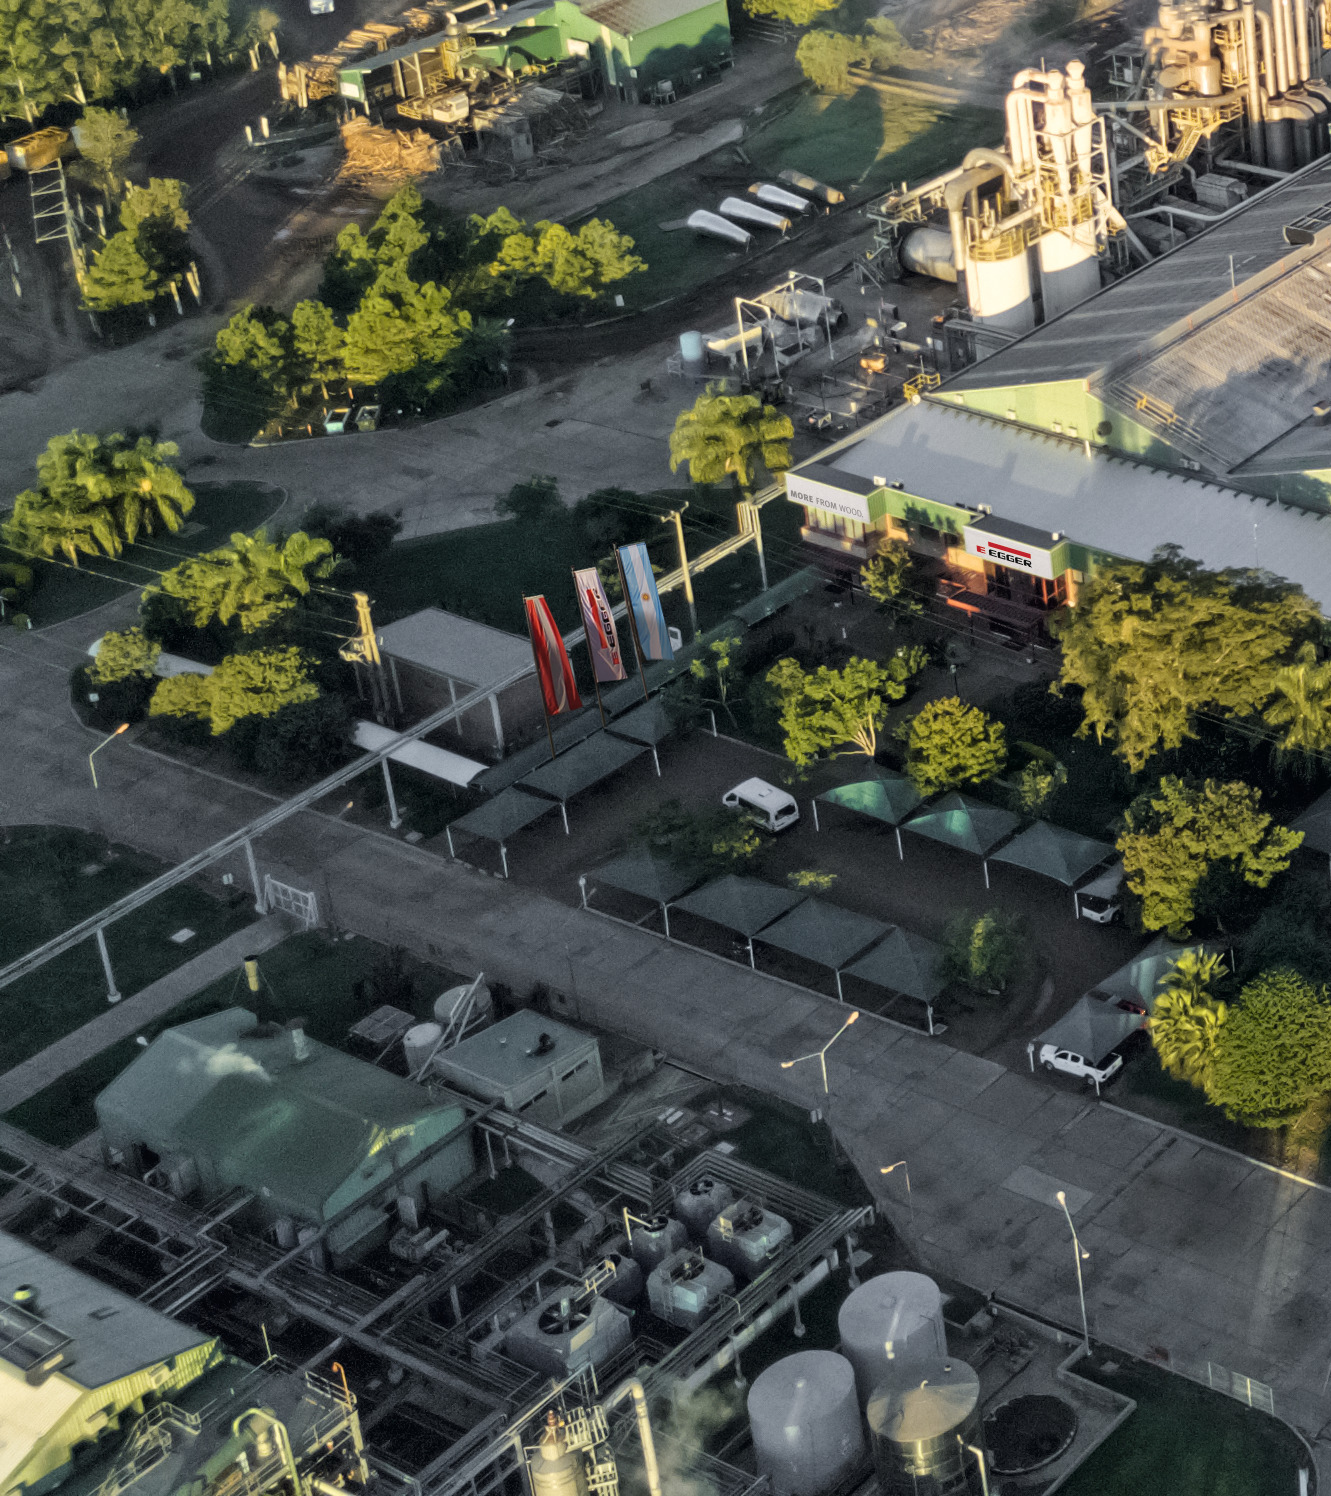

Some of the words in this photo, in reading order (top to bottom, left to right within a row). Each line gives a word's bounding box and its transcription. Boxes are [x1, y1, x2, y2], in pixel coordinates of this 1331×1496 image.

[790, 490, 814, 503] MORE
[815, 497, 837, 510] FROM
[839, 504, 864, 518] WOOD.
[988, 549, 1032, 568] EGGER
[592, 587, 616, 648] EGGR
